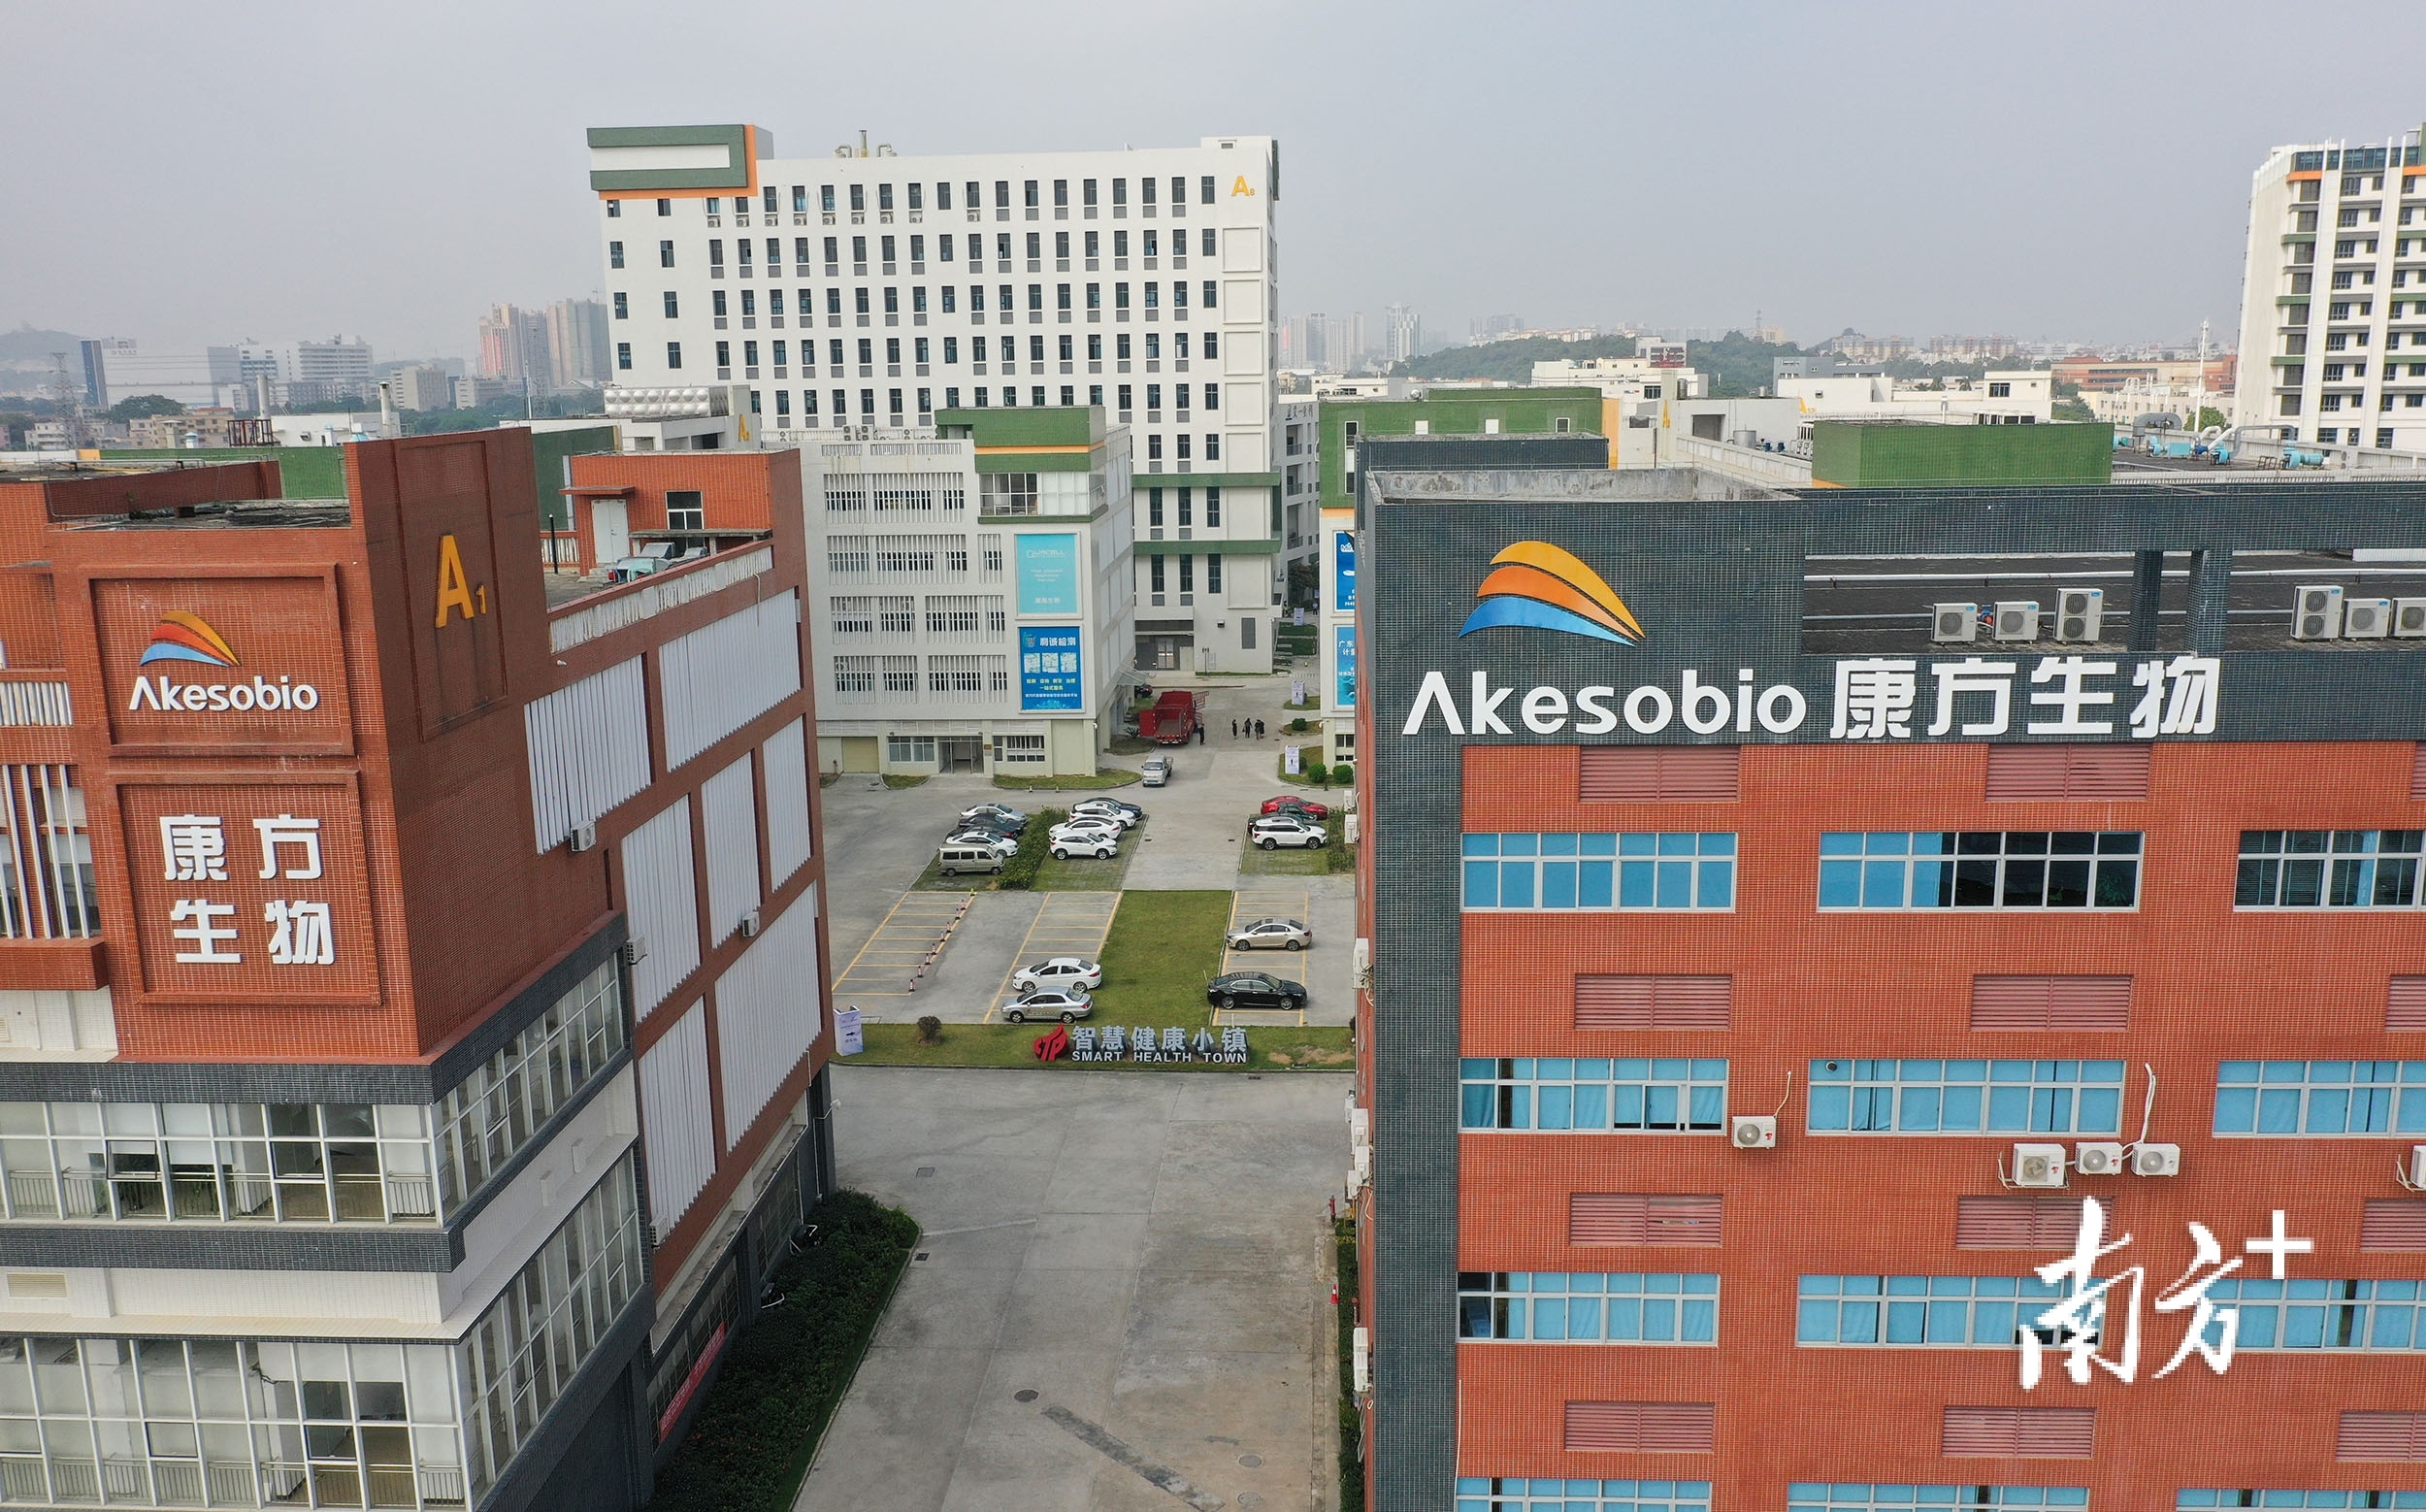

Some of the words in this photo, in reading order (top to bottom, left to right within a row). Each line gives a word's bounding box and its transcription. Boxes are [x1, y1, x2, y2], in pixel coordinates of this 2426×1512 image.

[435, 535, 487, 629] A1
[128, 674, 318, 711] Akesobio
[1401, 667, 1807, 736] Akesobio
[1829, 654, 2221, 740] 康方生物
[159, 813, 322, 881] 康方
[170, 899, 335, 965] 生物
[1070, 1025, 1248, 1054] 智慧健康小镇
[1071, 1051, 1123, 1063] SMART
[1133, 1051, 1193, 1064] HEALTH
[1202, 1052, 1247, 1064] TOWN
